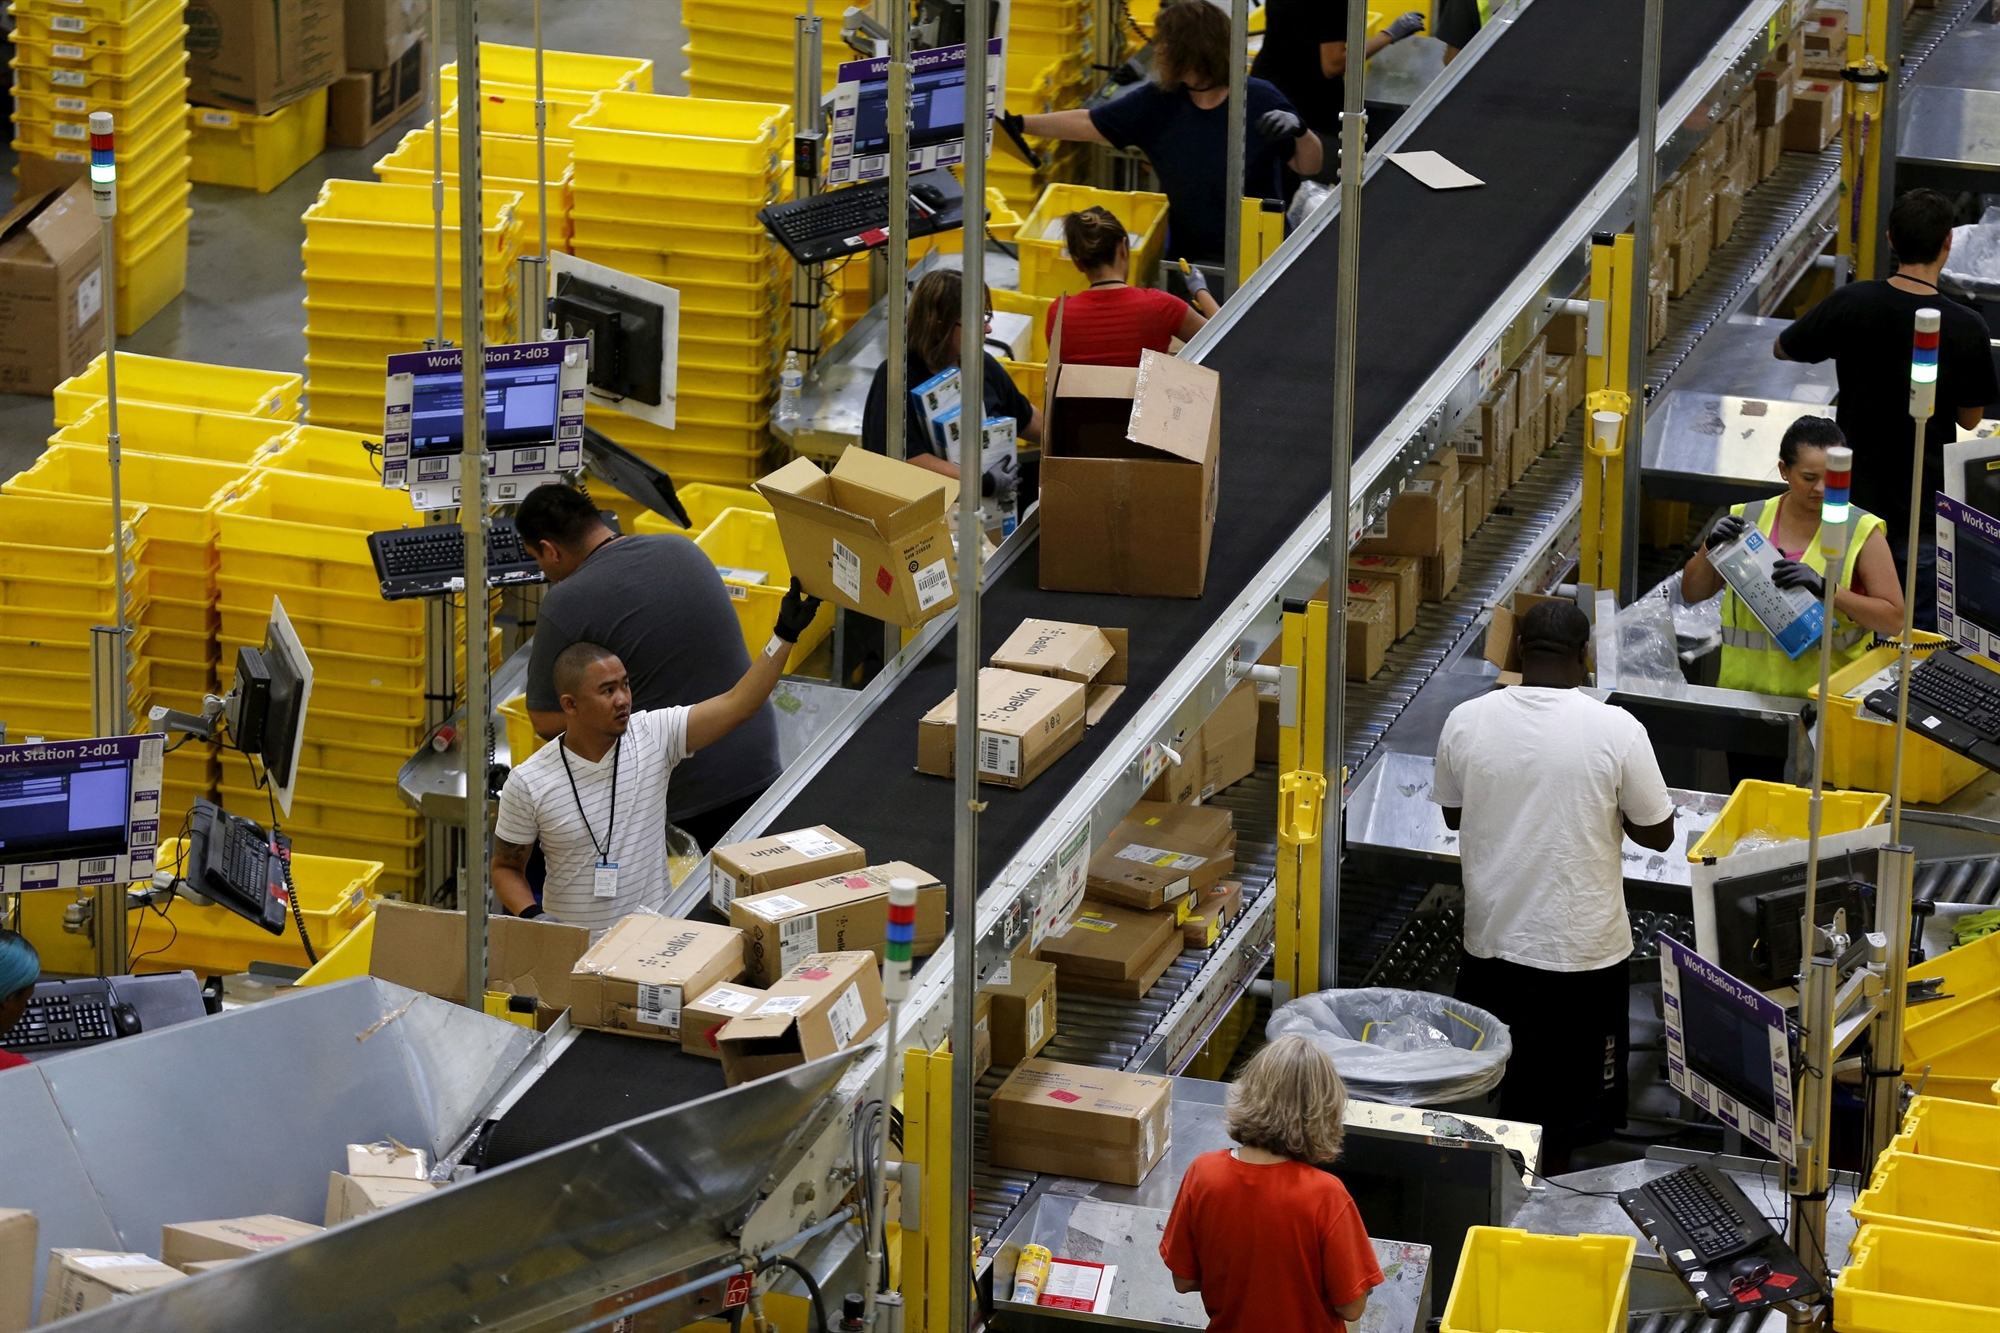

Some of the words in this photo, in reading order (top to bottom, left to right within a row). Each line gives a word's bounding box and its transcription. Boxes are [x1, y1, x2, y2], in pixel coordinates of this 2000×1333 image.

[485, 351, 510, 364] tion
[513, 347, 550, 361] 2-d03
[1961, 510, 1984, 531] Work
[1748, 535, 1759, 545] 12
[1026, 634, 1055, 657] belkin
[997, 687, 1041, 714] belkin
[0, 750, 20, 763] ork
[23, 748, 75, 763] Station
[79, 743, 120, 758] 2-d01
[750, 845, 791, 858] elkin
[656, 931, 700, 958] belkin
[837, 930, 846, 951] belk
[1683, 953, 1706, 978] Work
[1706, 968, 1736, 996] Station
[1736, 987, 1759, 1011] 2-c01
[728, 1289, 746, 1305] A7
